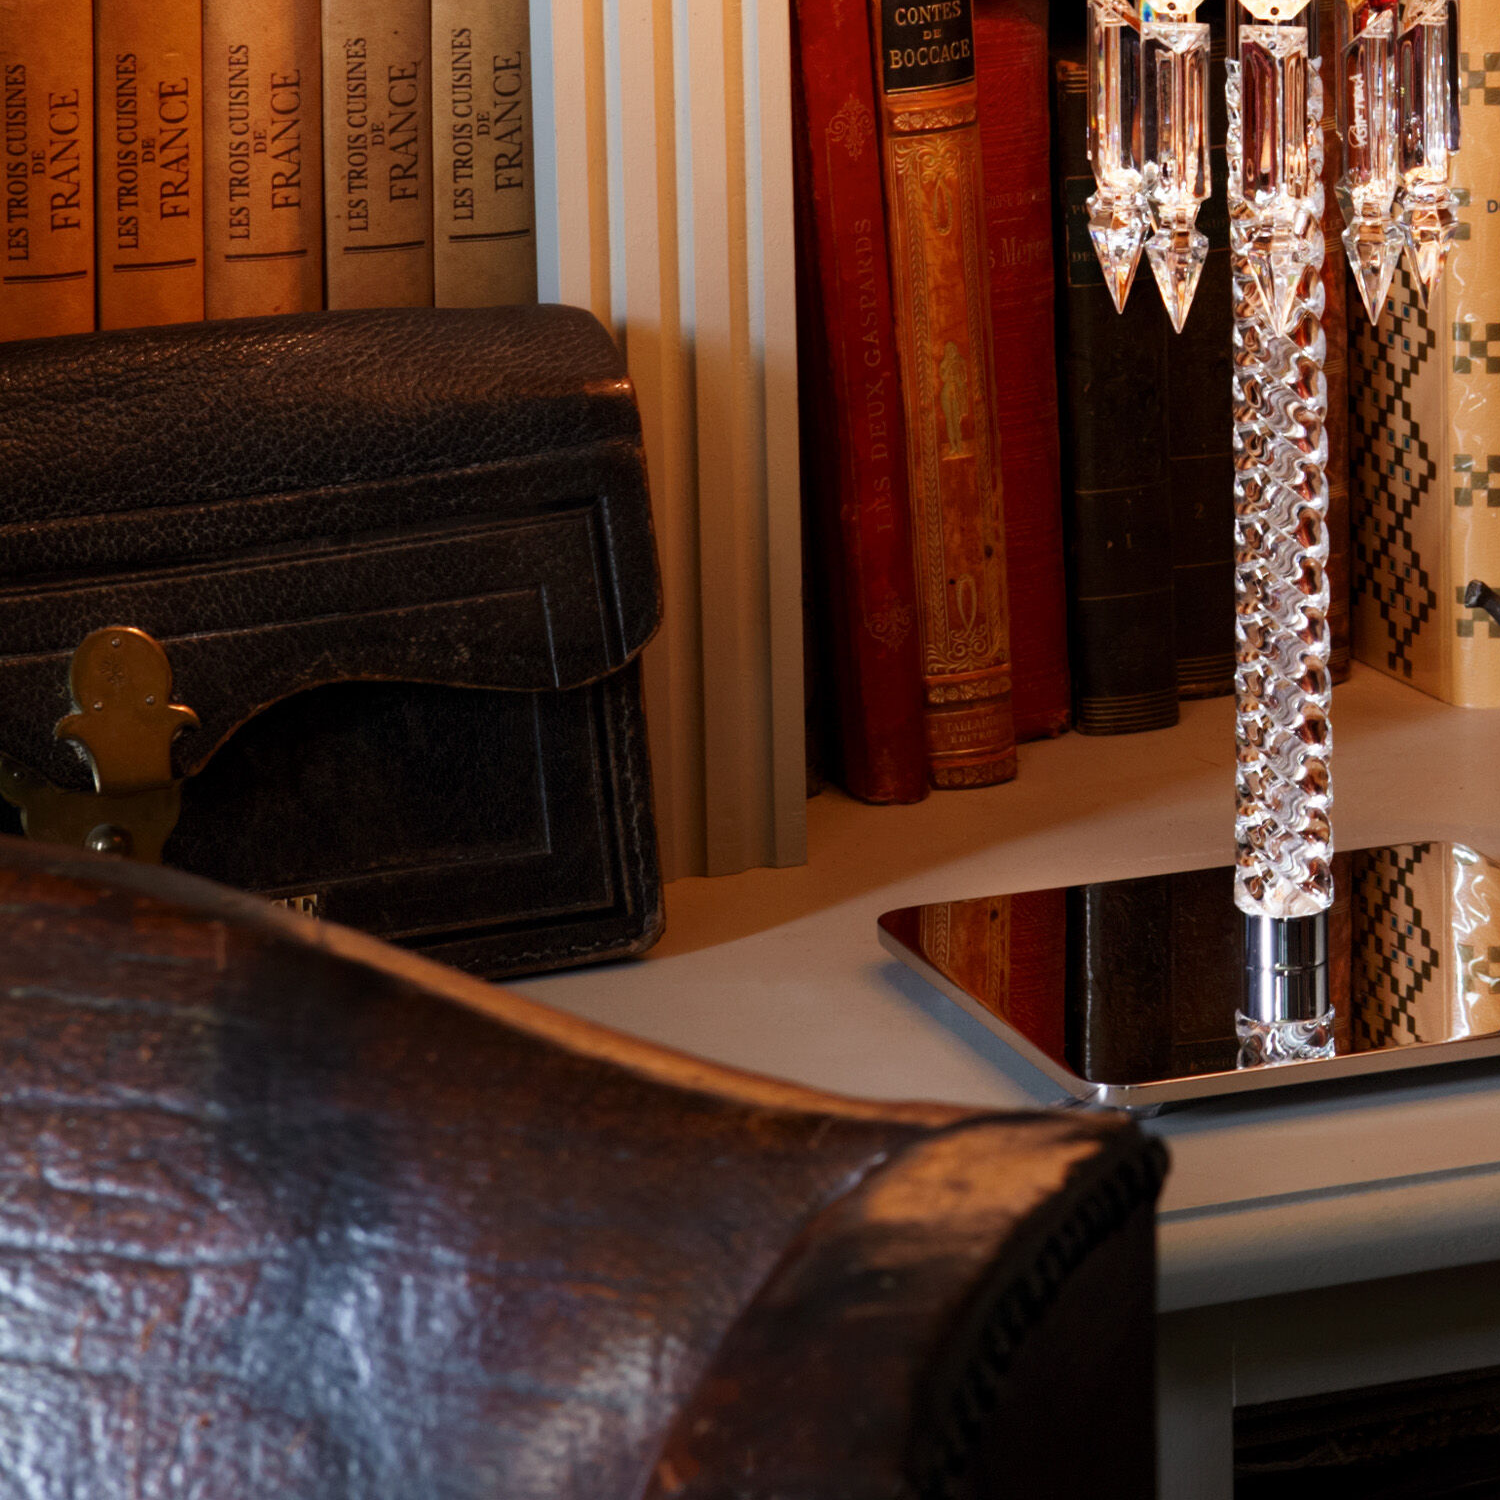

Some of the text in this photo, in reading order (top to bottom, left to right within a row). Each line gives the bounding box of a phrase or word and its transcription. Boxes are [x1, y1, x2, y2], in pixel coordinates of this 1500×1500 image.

[888, 37, 971, 70] BOCCACE
[894, 0, 961, 27] CONTES
[922, 28, 942, 41] DE
[4, 63, 29, 263] LES TROIS CUISINES
[32, 149, 46, 175] DE
[49, 88, 81, 233] FRANCE
[115, 52, 139, 250] LES TROIS CUISINES
[142, 137, 156, 164] DE
[158, 77, 190, 220] FRANCE
[227, 44, 250, 240] LES TROIS CUISINES
[253, 129, 267, 154] DE
[271, 69, 301, 212] FRANCE
[345, 37, 368, 232] LES TROIS CUISINES
[371, 121, 385, 146] DE
[388, 61, 419, 202] FRANCE
[451, 27, 474, 221] LES TROIS CUISINES
[477, 111, 490, 136] DE
[493, 50, 524, 193] FRANCE
[855, 217, 896, 534] LES GASPARDS
